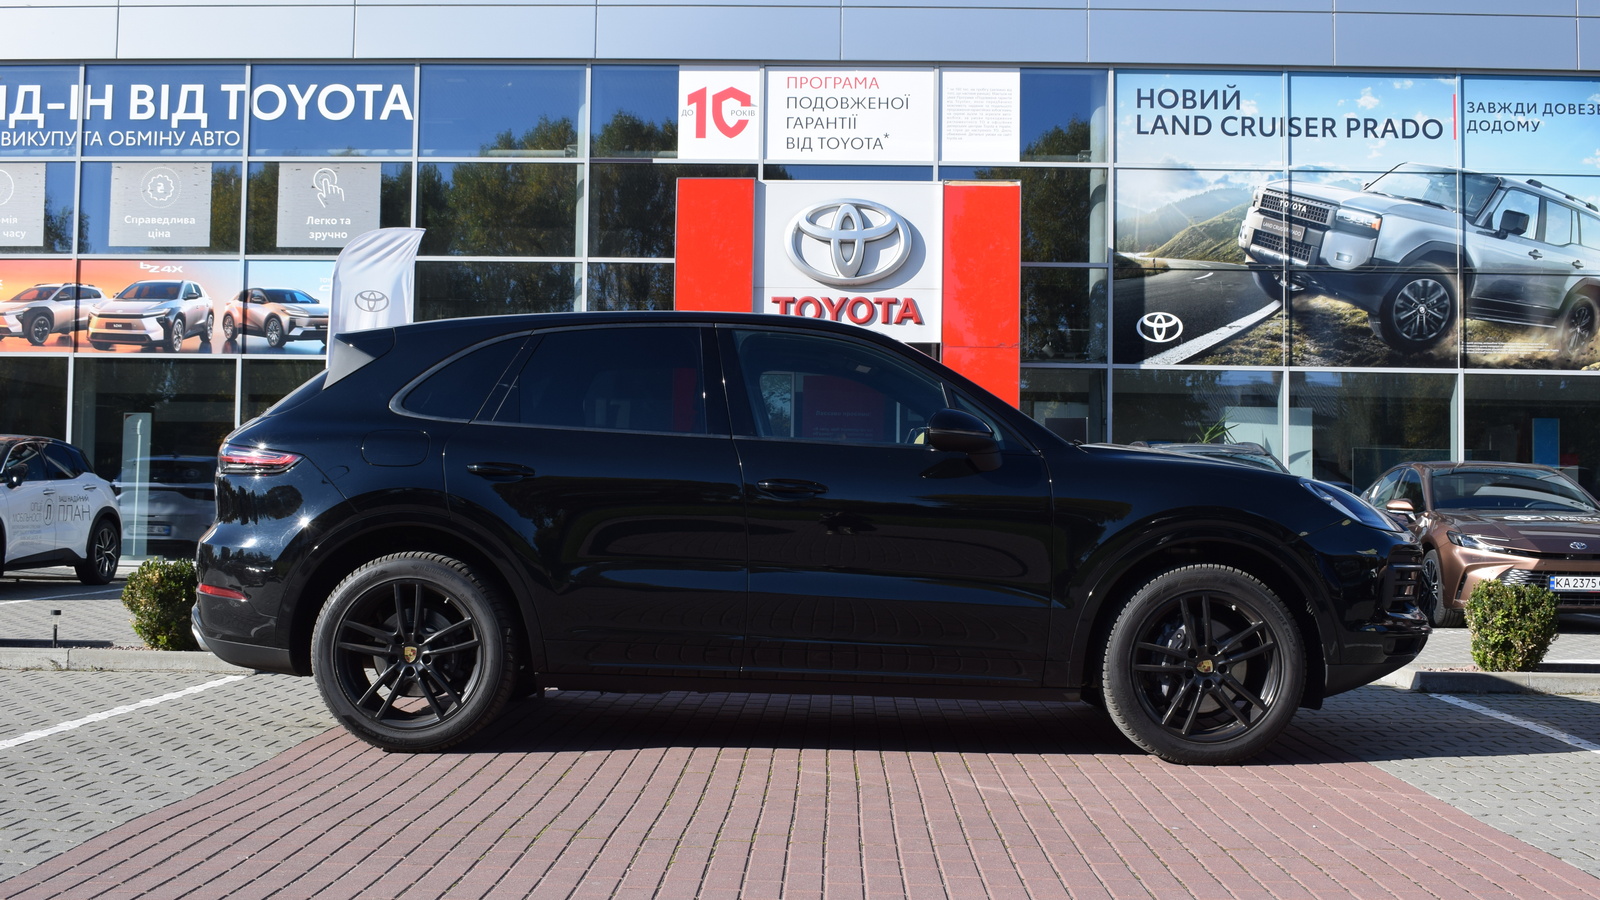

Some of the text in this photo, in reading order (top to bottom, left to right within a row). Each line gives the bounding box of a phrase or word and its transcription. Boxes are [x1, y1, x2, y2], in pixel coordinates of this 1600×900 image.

[787, 76, 880, 89] ПРОГРАМА
[786, 94, 911, 112] ПОДОВЖЕНОЇ
[1136, 84, 1241, 110] НОВИЙ
[0, 84, 414, 128] Д-ІН ВІД TOYOTA
[681, 109, 694, 117] ДО
[730, 109, 756, 117] РОКІВ
[1466, 101, 1537, 116] ЗАВЖДИ
[786, 114, 858, 129] ГАРАНТІЇ
[1136, 114, 1443, 140] LAND CRUISER PRADO
[1466, 120, 1541, 134] ДОДОМУ
[1, 130, 240, 146] ВИКУПУ ТА ОБМІНУ АВТО
[786, 137, 813, 152] ВІД
[124, 215, 196, 226] Справедлива
[306, 216, 338, 225] Легко
[3, 230, 26, 239] часу
[148, 229, 171, 239] ціна
[309, 231, 348, 241] зручно
[771, 296, 923, 325] TOYOTA
[58, 504, 91, 521] ПЛАН
[1555, 578, 1597, 588] KA 2375
